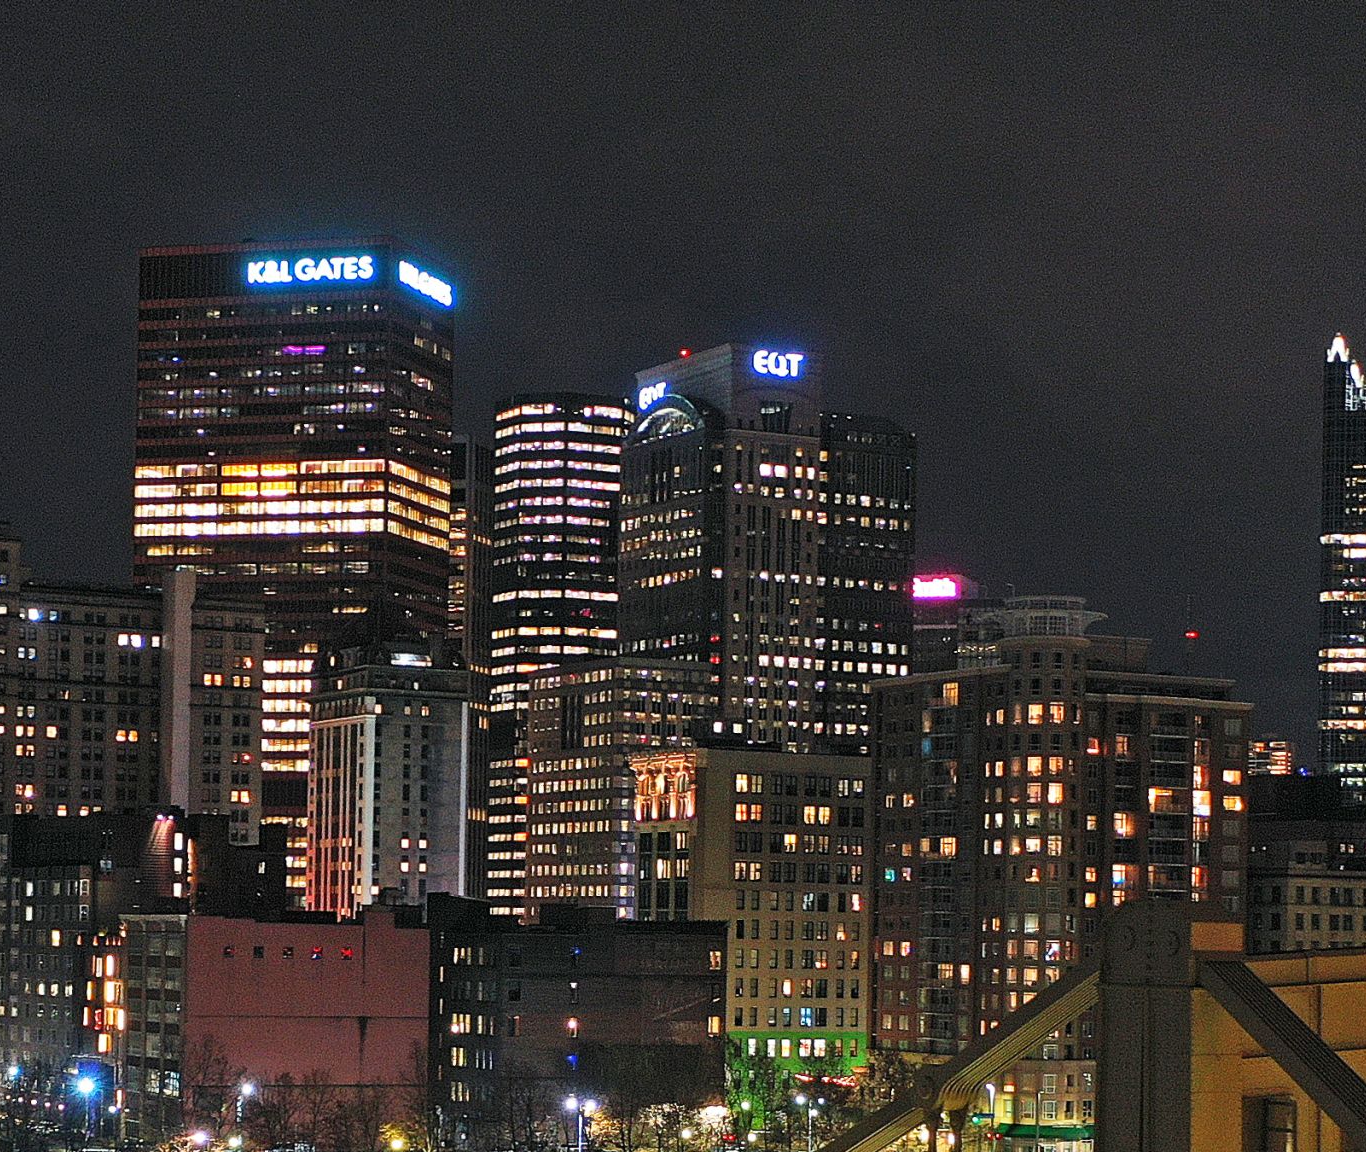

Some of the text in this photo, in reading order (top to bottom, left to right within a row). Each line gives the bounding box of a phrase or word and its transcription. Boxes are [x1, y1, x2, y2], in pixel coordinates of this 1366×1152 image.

[247, 255, 374, 284] K&L GATES
[753, 350, 804, 377] EQT
